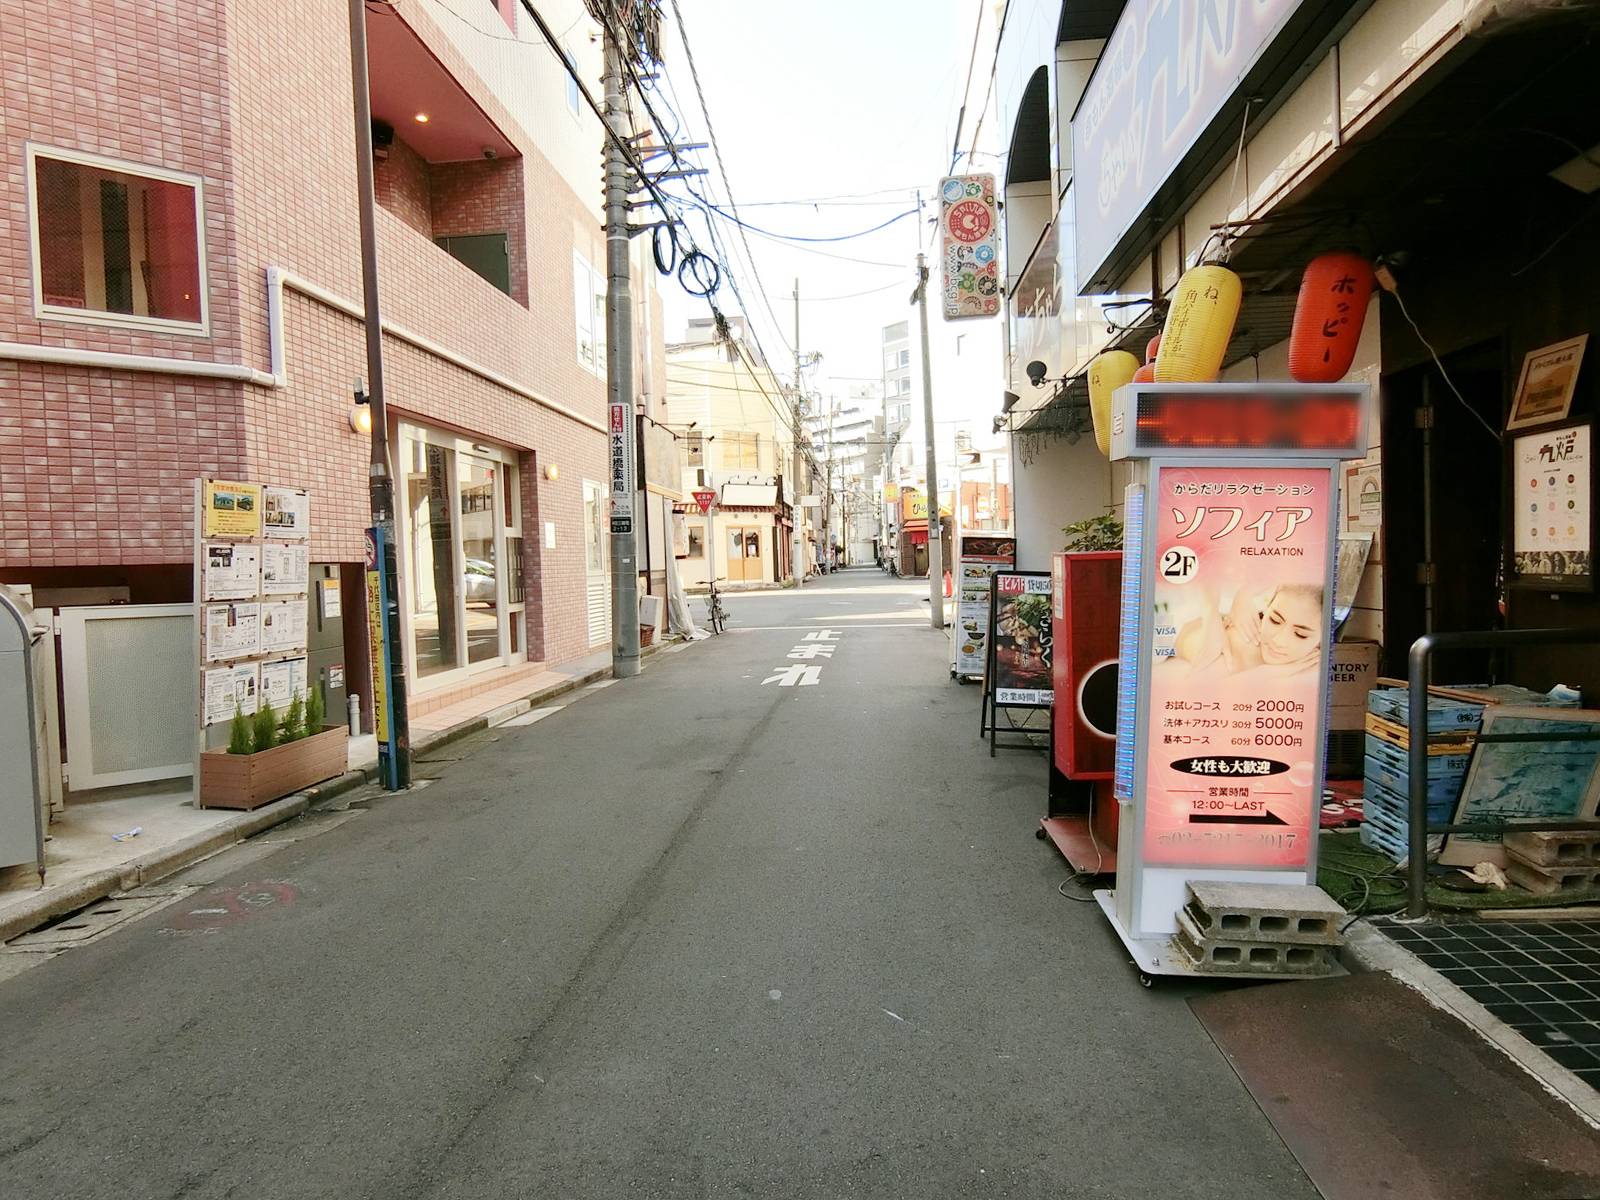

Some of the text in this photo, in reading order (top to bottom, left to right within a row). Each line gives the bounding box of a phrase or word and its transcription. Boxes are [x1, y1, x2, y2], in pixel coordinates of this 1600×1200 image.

[948, 243, 959, 316] www.bcg.jp
[1203, 285, 1218, 304] ね、
[1321, 274, 1357, 363] ホッピー
[612, 434, 624, 492] 水道橋薬局
[1174, 483, 1315, 497] からだリラクゼーション
[1172, 506, 1313, 542] ソフィア
[1240, 547, 1304, 557] RELAXATION
[1164, 551, 1196, 577] 2F
[1155, 627, 1177, 636] VISA
[760, 629, 842, 687] 止まれ
[1154, 648, 1177, 657] VISA
[999, 691, 1035, 702] 営業時間
[1165, 699, 1304, 713] お試しコース 20分 2000円
[1231, 720, 1252, 729] 30分
[1255, 717, 1303, 730] 5000円
[1163, 734, 1302, 747] 基本コース 60分 6000円
[1190, 759, 1271, 774] 女性も大歓迎
[1208, 787, 1249, 797] 営業時間
